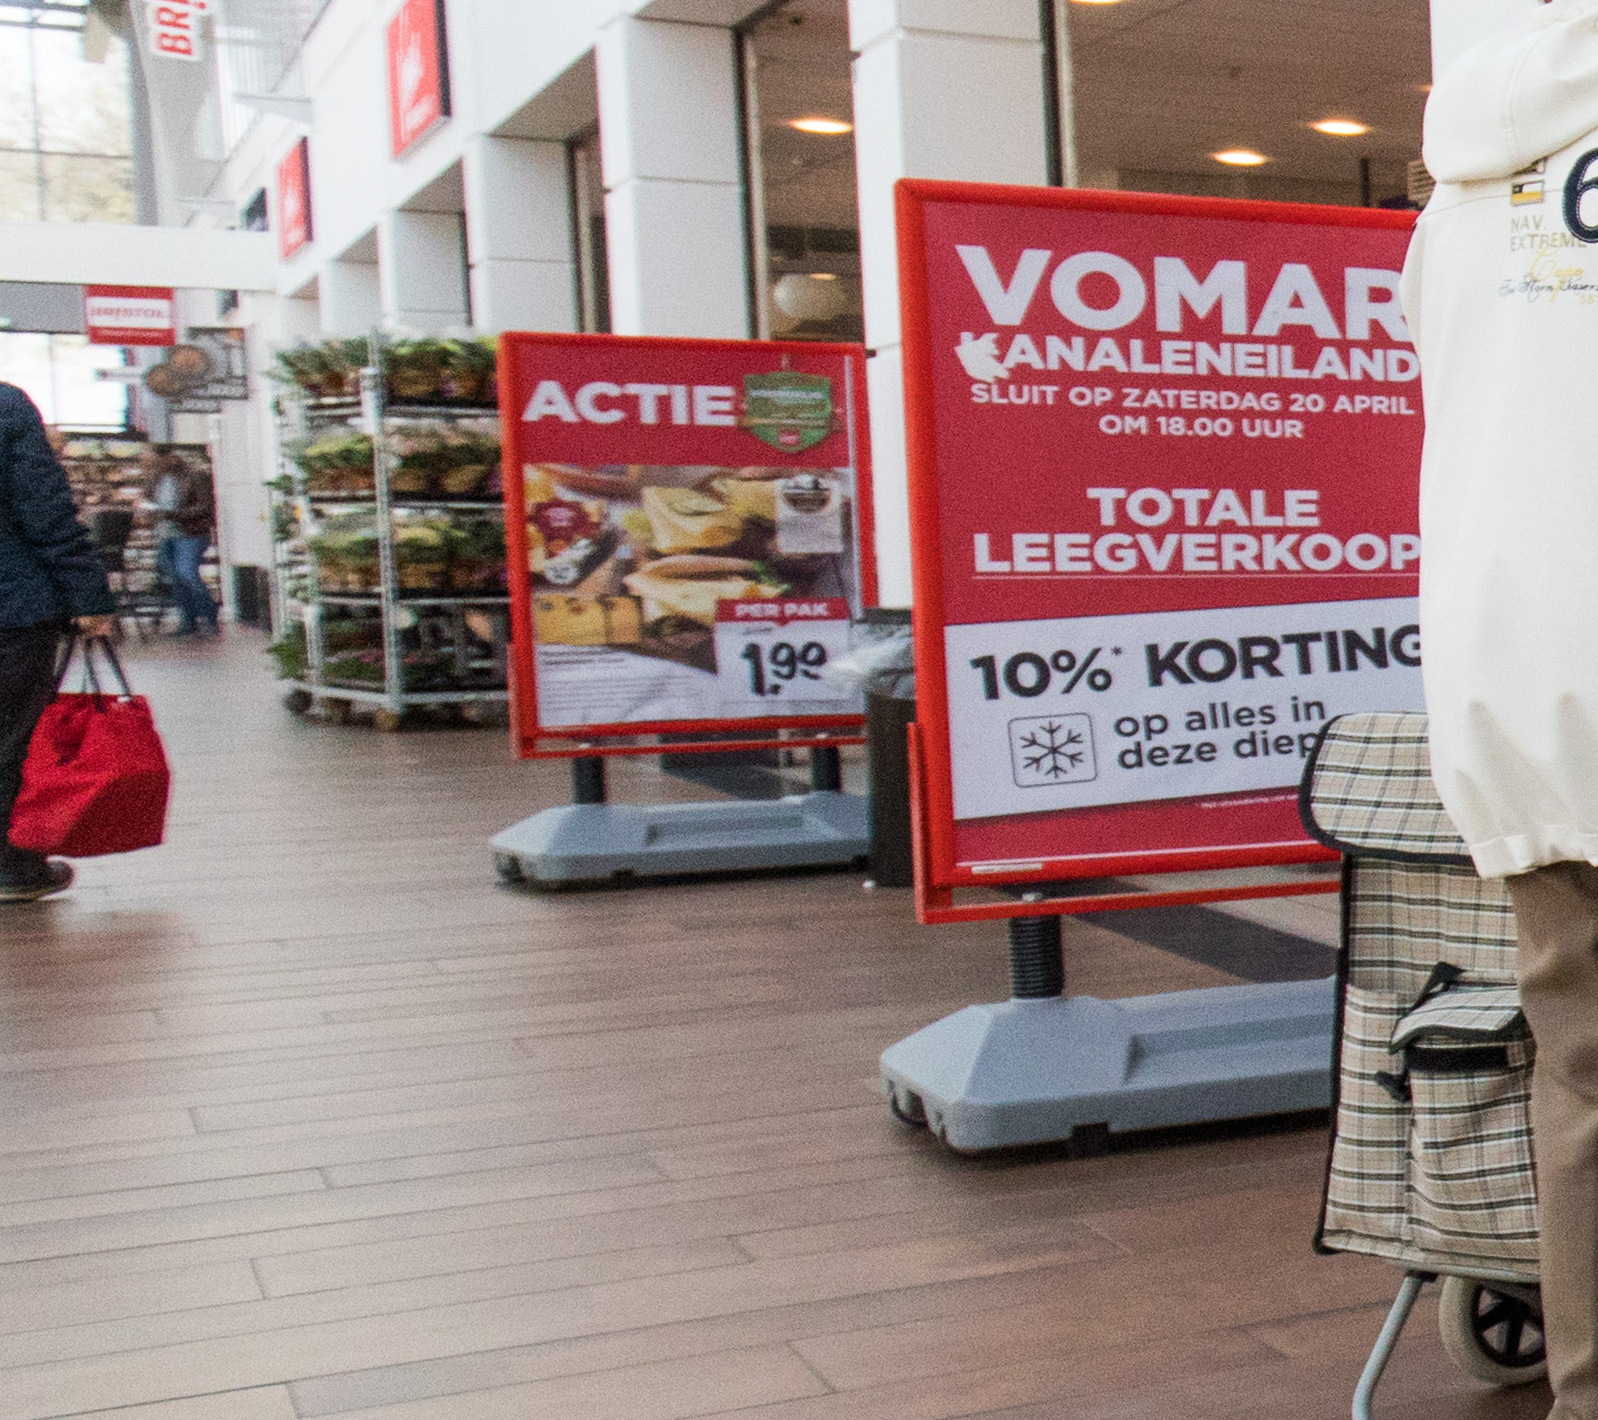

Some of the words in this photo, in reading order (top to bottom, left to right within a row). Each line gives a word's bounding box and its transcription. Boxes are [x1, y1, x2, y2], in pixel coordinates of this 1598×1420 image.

[1509, 230, 1588, 253] EXTREME
[955, 244, 1411, 342] VOMAR
[520, 379, 737, 427] ACTIE
[971, 382, 1059, 406] SLUIT
[1068, 385, 1113, 408] OP
[1122, 388, 1281, 412] ZATERDAG
[1290, 393, 1325, 413] 20
[1332, 394, 1415, 416] APRIL
[1099, 415, 1147, 436] OM
[1156, 415, 1233, 437] 18.00
[1242, 418, 1304, 439] UUR
[1086, 488, 1320, 527] TOTALE
[973, 533, 1421, 573] LEEGVERKOOP
[1145, 623, 1421, 688] KORTING
[1114, 711, 1169, 741] op
[1185, 701, 1277, 733] alles
[1292, 696, 1327, 723] in
[1117, 733, 1218, 770] deze
[1233, 728, 1321, 760] diep
